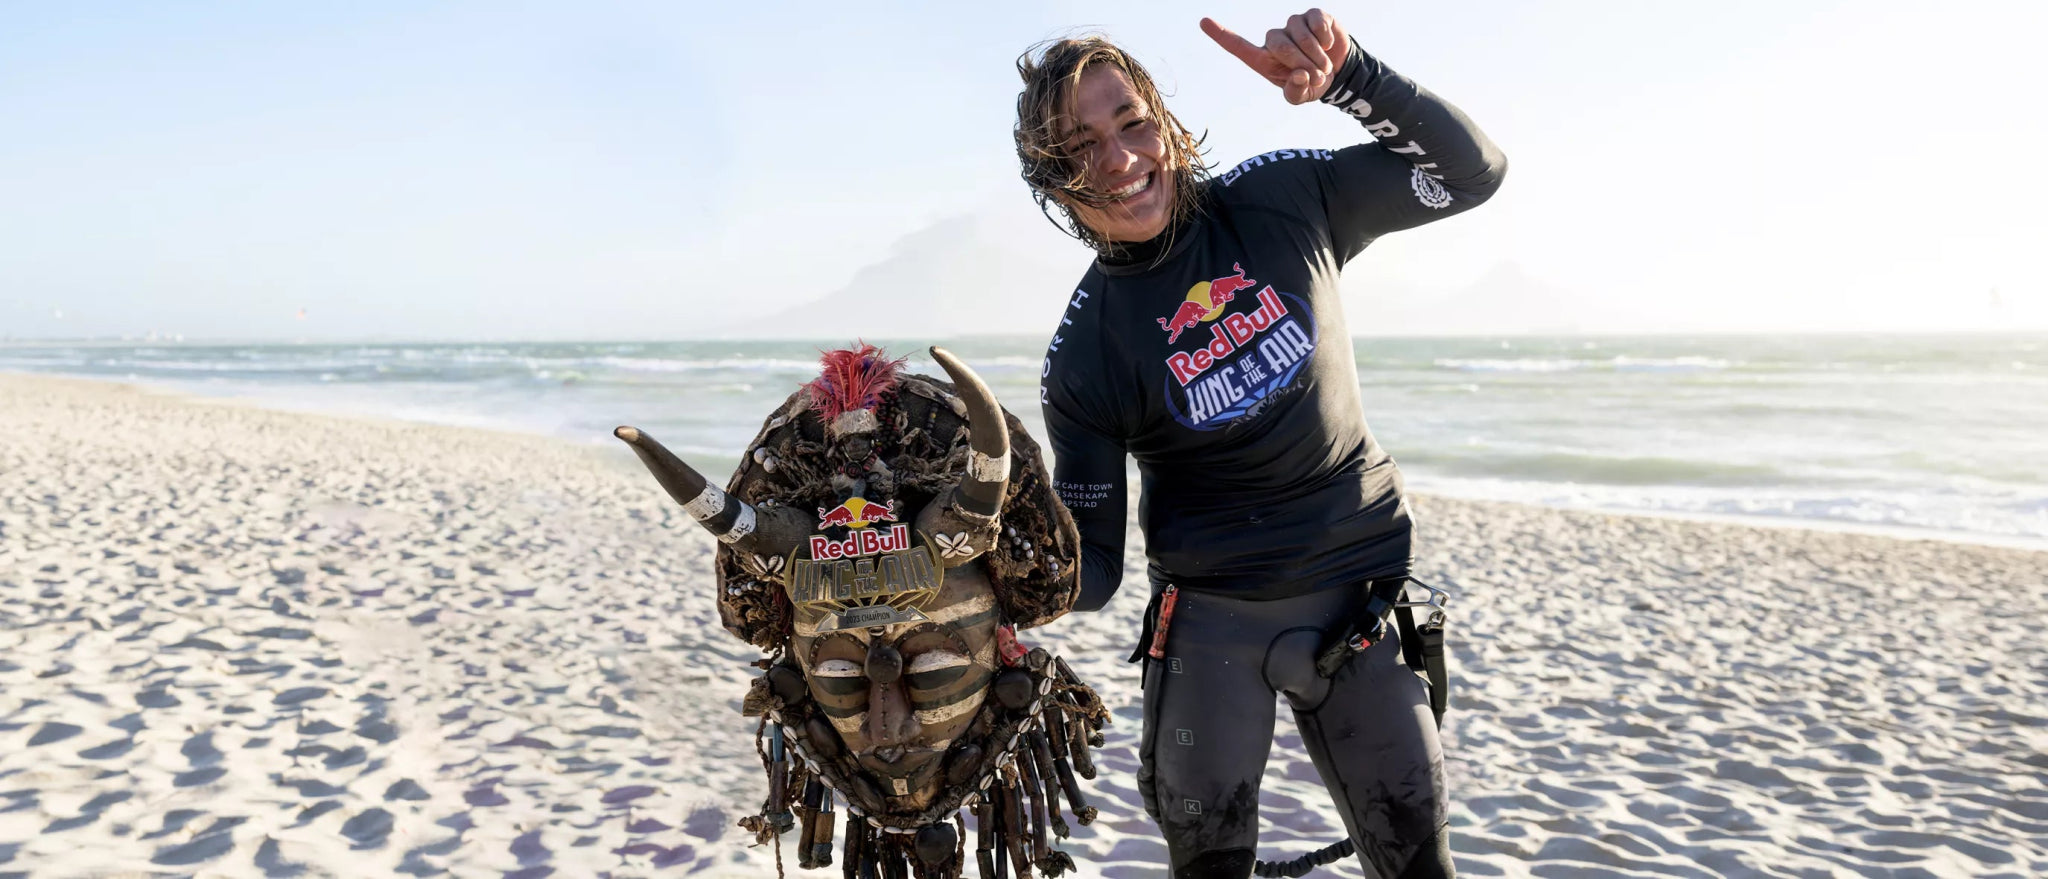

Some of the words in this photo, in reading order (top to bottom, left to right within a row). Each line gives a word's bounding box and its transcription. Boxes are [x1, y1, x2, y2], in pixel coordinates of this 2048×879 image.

[1166, 322, 1235, 387] Red
[1222, 284, 1288, 347] Bull
[1259, 319, 1314, 374] AIR
[1239, 354, 1257, 372] OF
[1242, 364, 1267, 388] THE
[1186, 366, 1245, 425] KING
[1062, 482, 1085, 491] CAPE
[1088, 483, 1113, 491] TOWN
[1062, 490, 1108, 500] SASEKAPA
[809, 531, 860, 561] Red
[860, 524, 910, 555] Bull
[793, 560, 852, 602] KING
[882, 550, 940, 594] AIR
[861, 611, 891, 622] CHAMPION
